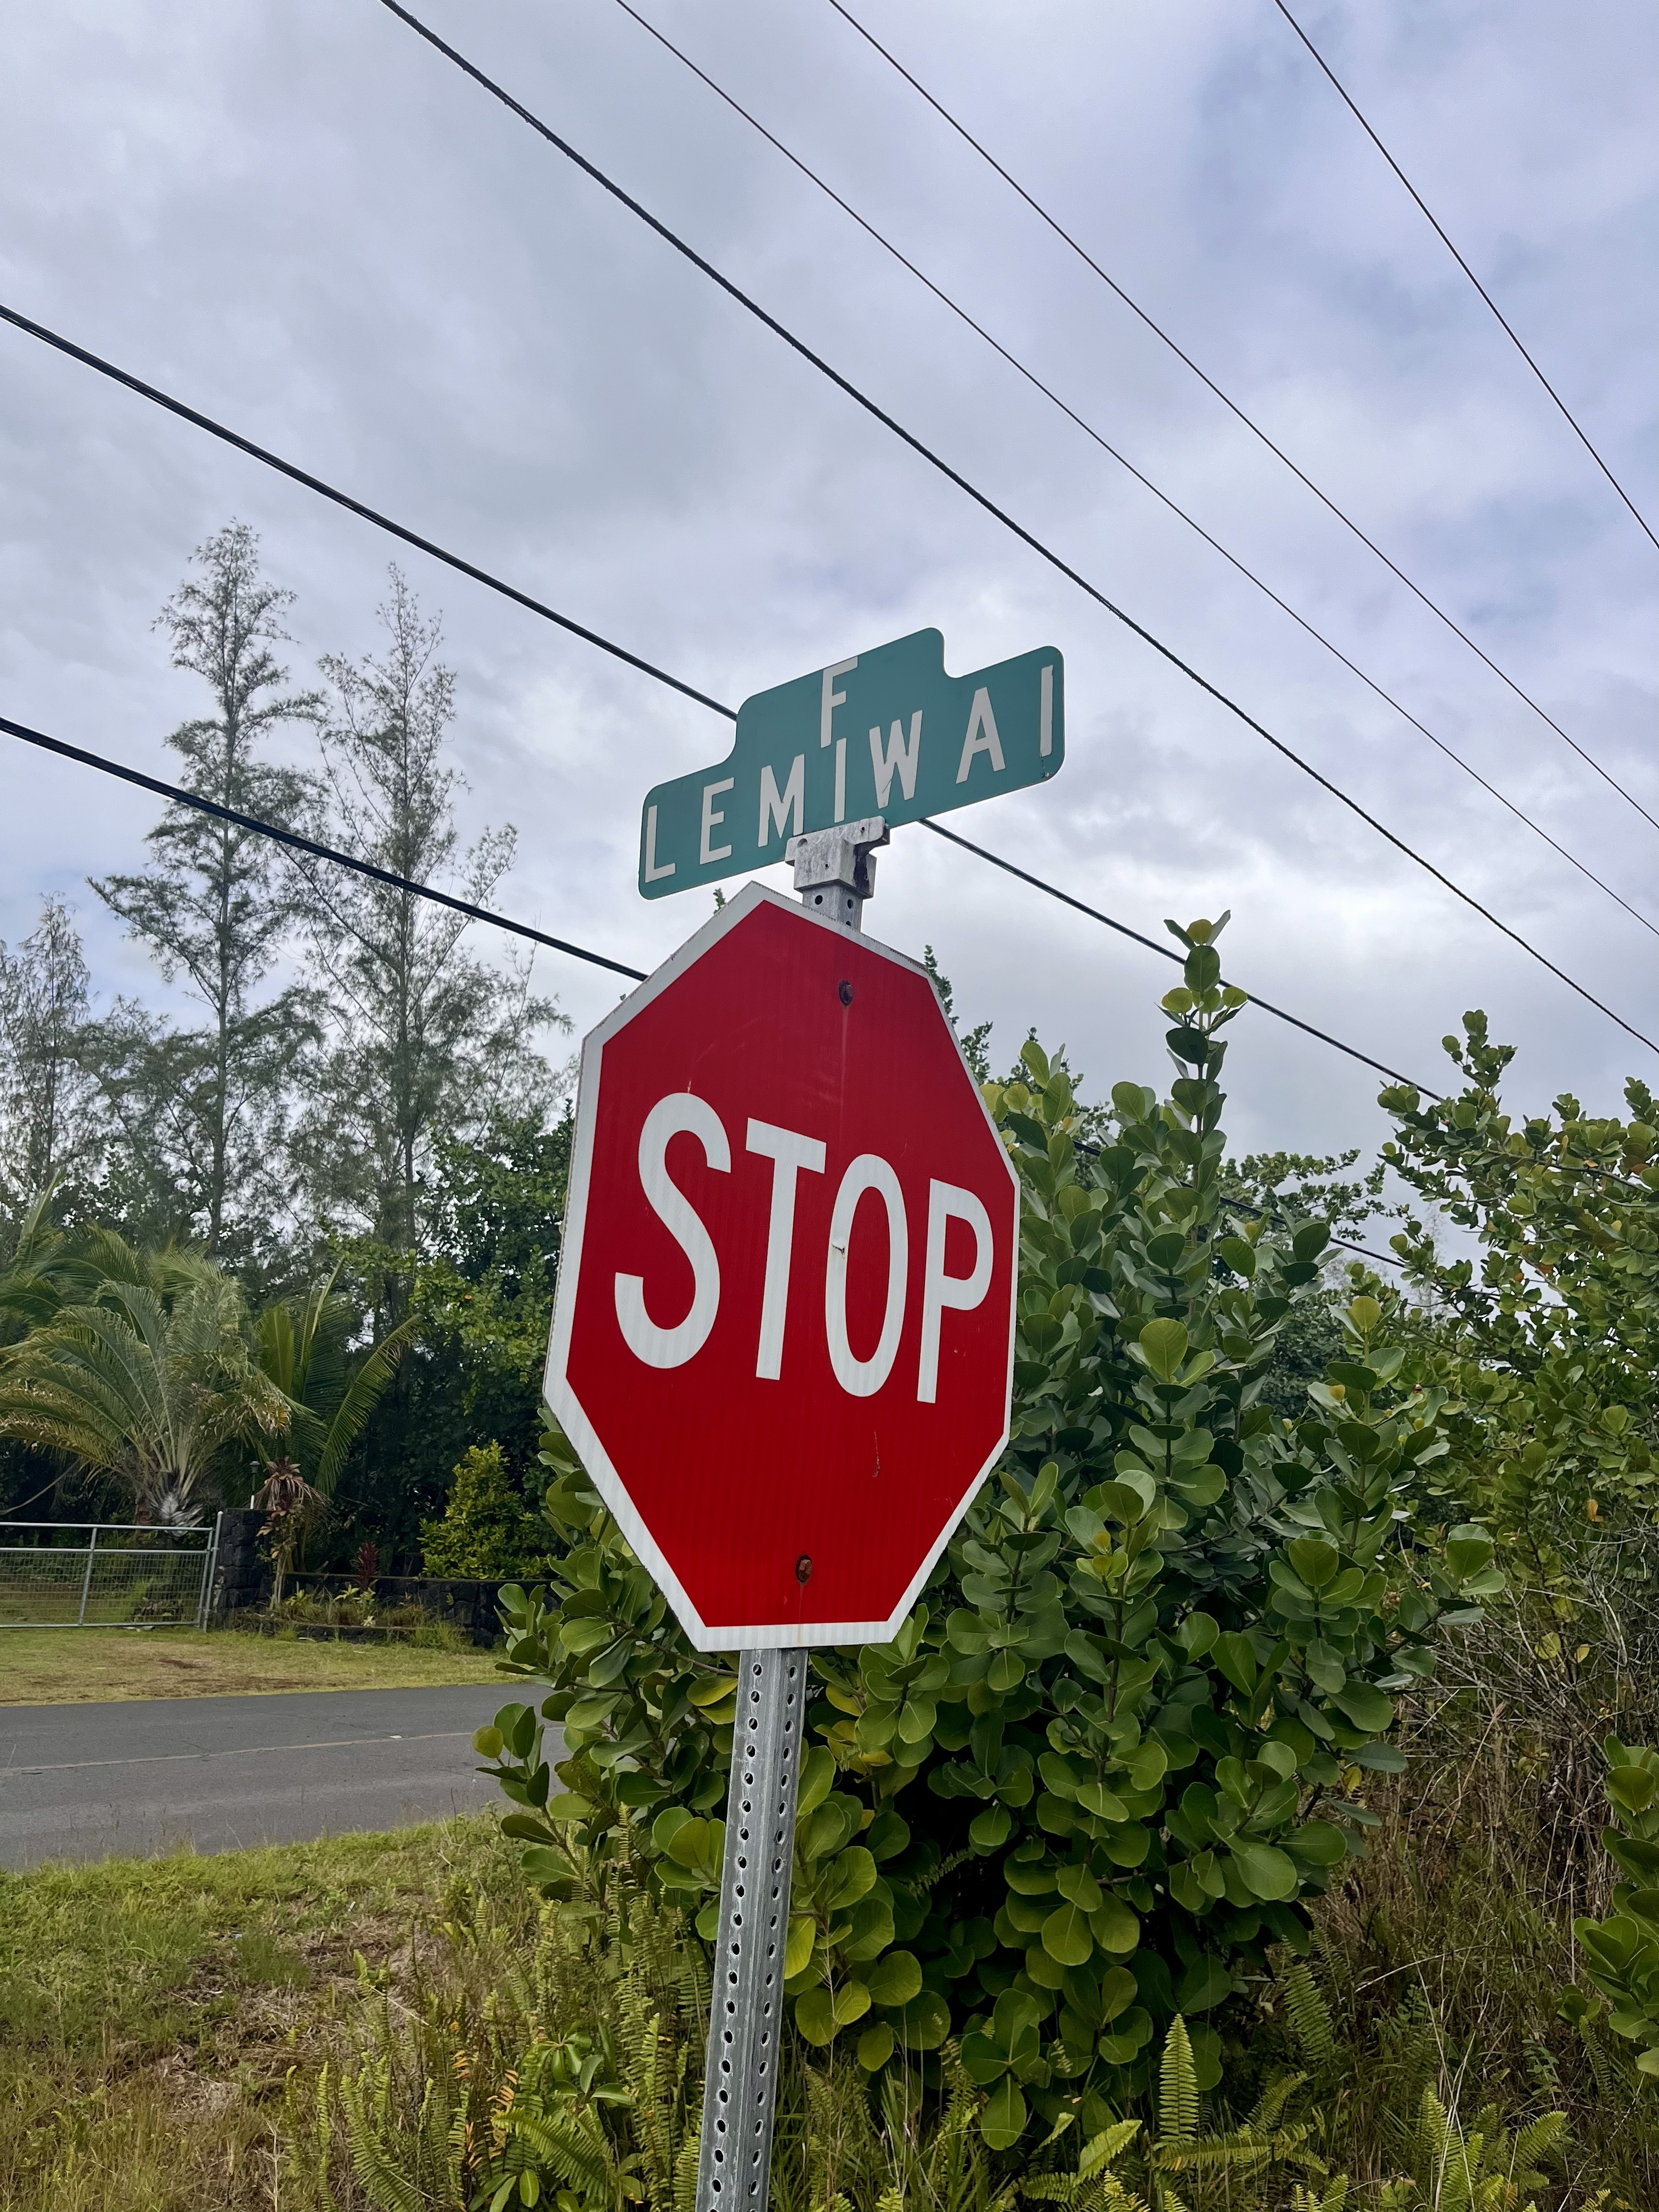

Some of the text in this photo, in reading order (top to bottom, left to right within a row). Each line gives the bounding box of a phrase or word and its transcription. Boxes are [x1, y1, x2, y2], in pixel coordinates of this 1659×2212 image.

[645, 664, 1053, 883] LEMIWAI
[821, 656, 858, 748] F
[614, 1092, 994, 1404] STOP
